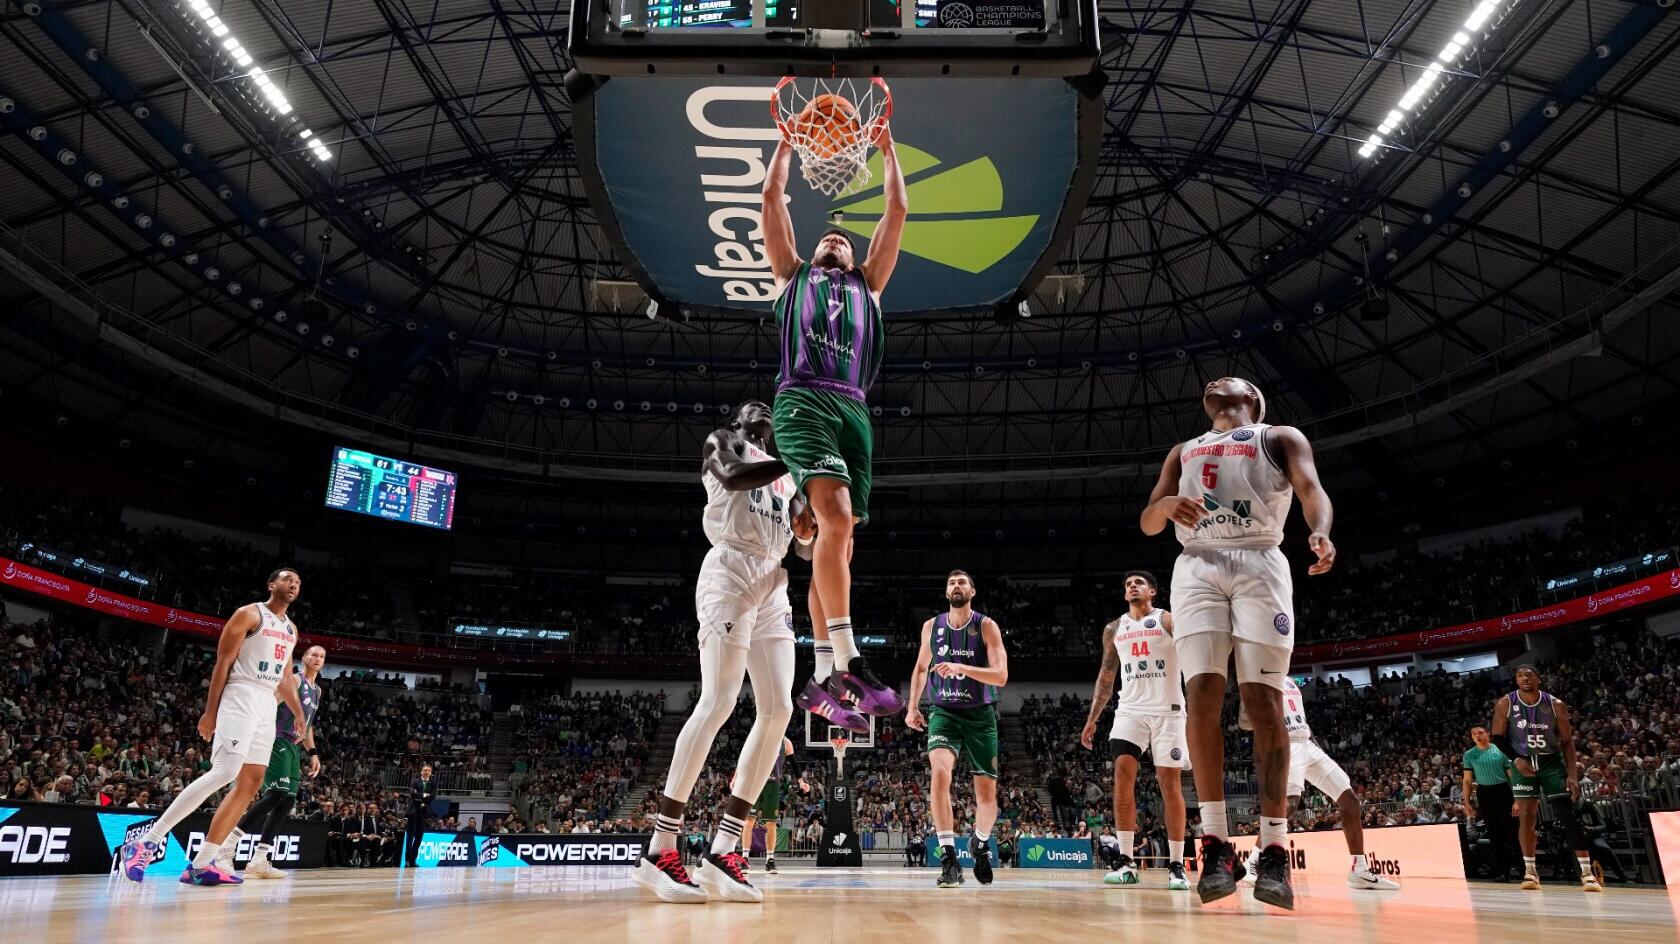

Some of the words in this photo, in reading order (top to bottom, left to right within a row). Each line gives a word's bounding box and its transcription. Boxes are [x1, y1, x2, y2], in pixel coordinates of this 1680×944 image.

[698, 12, 723, 22] PERRY
[976, 11, 1042, 20] CHAMPIONS
[828, 299, 844, 321] 7
[376, 459, 389, 469] 61
[407, 466, 420, 476] 44
[1201, 463, 1218, 489] 5
[386, 483, 407, 496] 7:43
[949, 648, 975, 659] Unicaja
[1131, 641, 1151, 658] 44
[1527, 734, 1547, 749] 55
[418, 842, 469, 861] POWERADE
[517, 843, 642, 861] POWERADE
[828, 847, 852, 855] Unicaja
[1047, 850, 1088, 862] Unicaja
